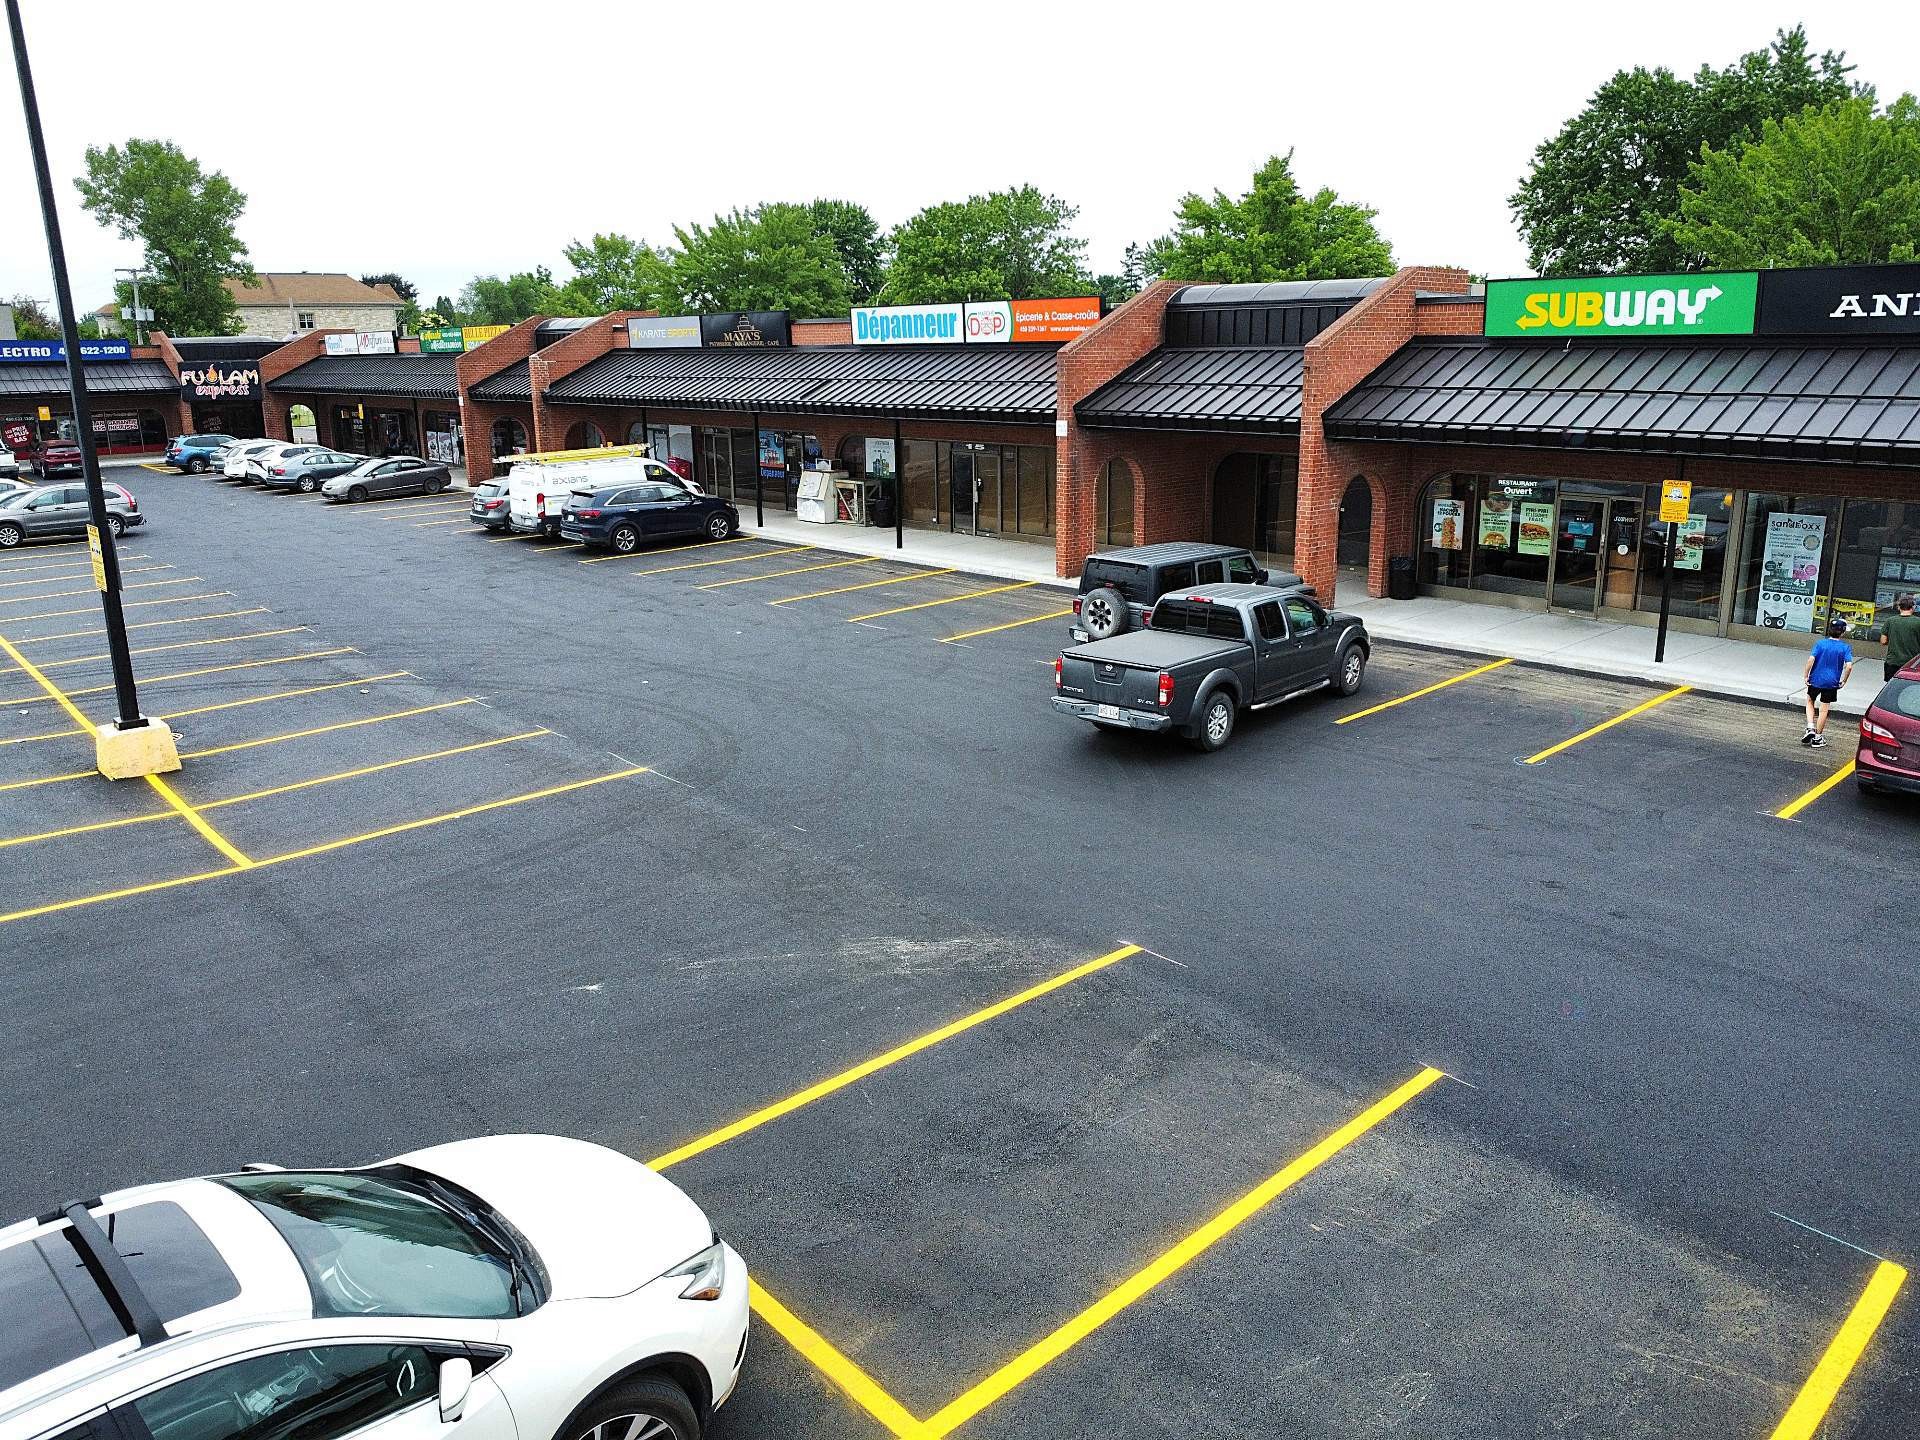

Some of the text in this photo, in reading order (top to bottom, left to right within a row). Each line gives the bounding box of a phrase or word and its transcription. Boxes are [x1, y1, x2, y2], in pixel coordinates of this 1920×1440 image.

[1516, 284, 1724, 330] SUBWAY
[1829, 293, 1920, 318] AN
[1015, 310, 1099, 323] Épicerie & Casse-croûte
[857, 309, 957, 342] Dépanneur
[724, 332, 761, 341] MAYA'S
[80, 346, 126, 355] 622-1200
[181, 369, 259, 386] FU LAM
[195, 385, 250, 400] express
[552, 475, 589, 485] axians
[1498, 479, 1538, 487] RESTAURANT
[1503, 486, 1533, 495] Ouvert
